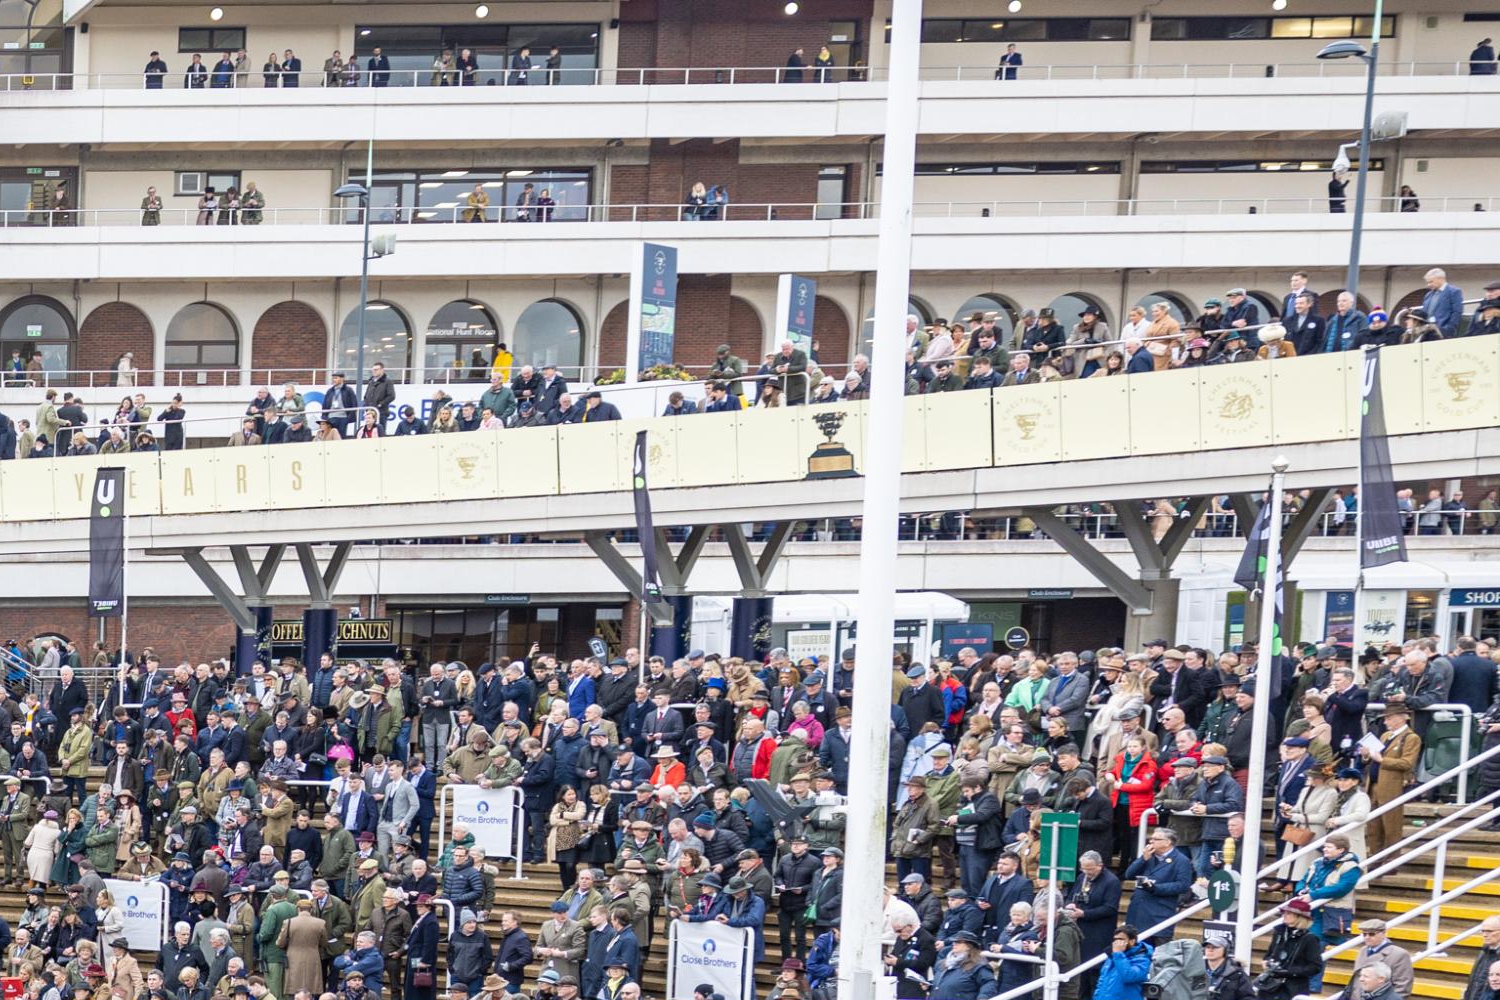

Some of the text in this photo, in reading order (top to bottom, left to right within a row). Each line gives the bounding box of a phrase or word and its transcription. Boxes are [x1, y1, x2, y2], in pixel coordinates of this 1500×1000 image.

[426, 328, 454, 336] ational
[456, 328, 473, 336] Hunt
[1366, 535, 1399, 550] UNIBE
[272, 622, 388, 641] OFFE UGHNUTS
[477, 816, 508, 825] Brothers
[1213, 880, 1230, 900] 1st
[127, 910, 157, 919] Brothers
[681, 954, 737, 969] Close Brothers
